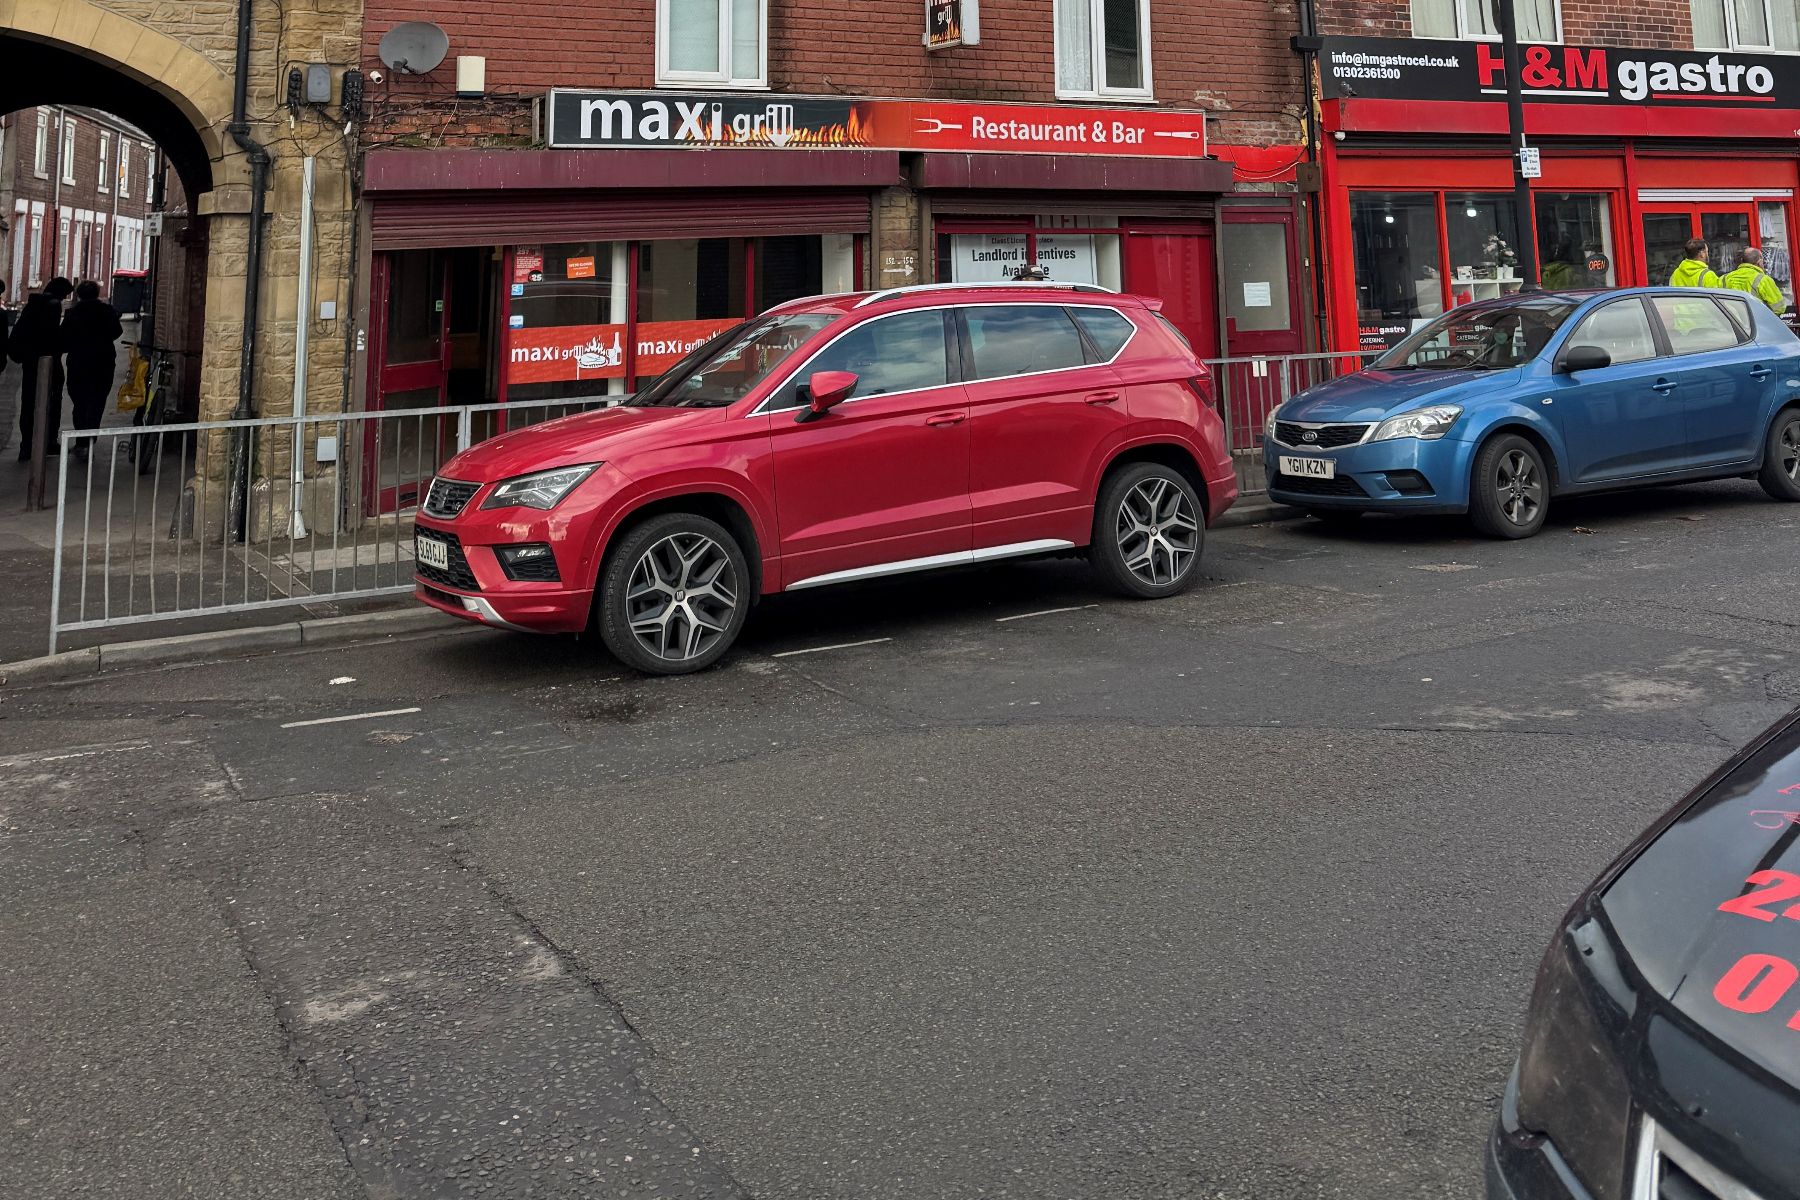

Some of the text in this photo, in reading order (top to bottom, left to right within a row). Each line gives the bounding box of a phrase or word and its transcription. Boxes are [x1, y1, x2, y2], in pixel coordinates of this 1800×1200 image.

[937, 5, 953, 25] grill
[1331, 52, 1460, 68] info@hmgastrocel.co.uk
[1333, 66, 1401, 80] 01302361300
[1476, 44, 1775, 101] H&M gastro
[580, 99, 794, 147] maxi grill
[972, 116, 1146, 144] Restaurant & Bar
[972, 248, 1018, 262] Landlord
[1589, 260, 1606, 271] OPEN
[1360, 325, 1406, 335] H&M gastro
[511, 346, 560, 363] maxi
[637, 340, 682, 356] maxi
[1287, 457, 1327, 475] YG11 KZN
